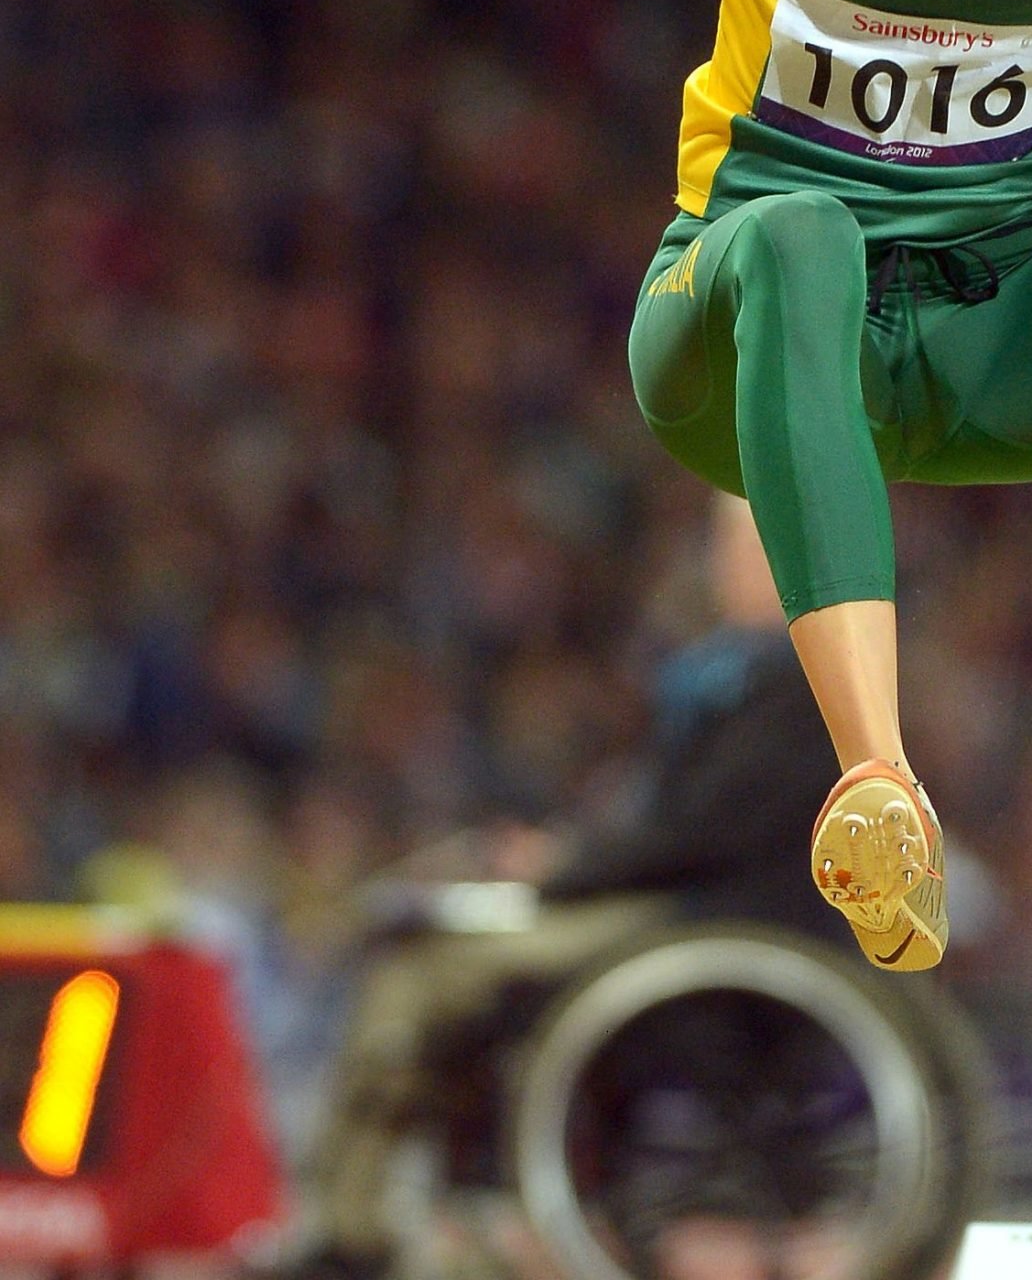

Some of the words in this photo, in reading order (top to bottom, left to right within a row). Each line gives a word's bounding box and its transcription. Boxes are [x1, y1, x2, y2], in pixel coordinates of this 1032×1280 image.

[852, 13, 994, 52] Sainsbury's
[804, 42, 1027, 134] 1016
[865, 143, 904, 157] London
[906, 145, 933, 158] 2012
